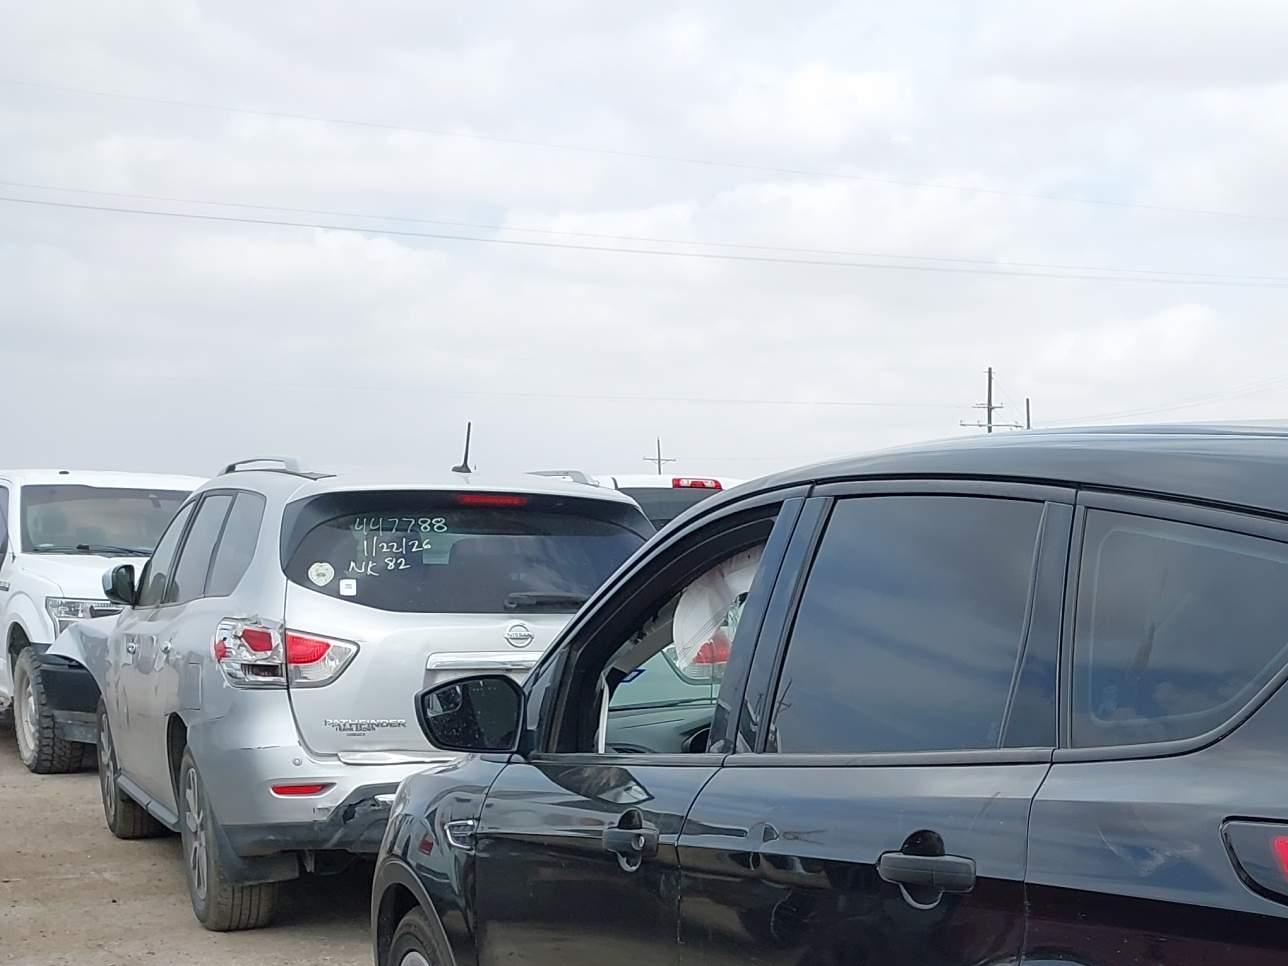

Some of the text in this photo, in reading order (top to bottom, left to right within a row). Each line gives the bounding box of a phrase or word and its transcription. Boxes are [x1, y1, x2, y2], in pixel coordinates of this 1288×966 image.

[354, 517, 448, 537] 447788
[384, 557, 411, 570] 82
[323, 719, 407, 729] PATHFINDER
